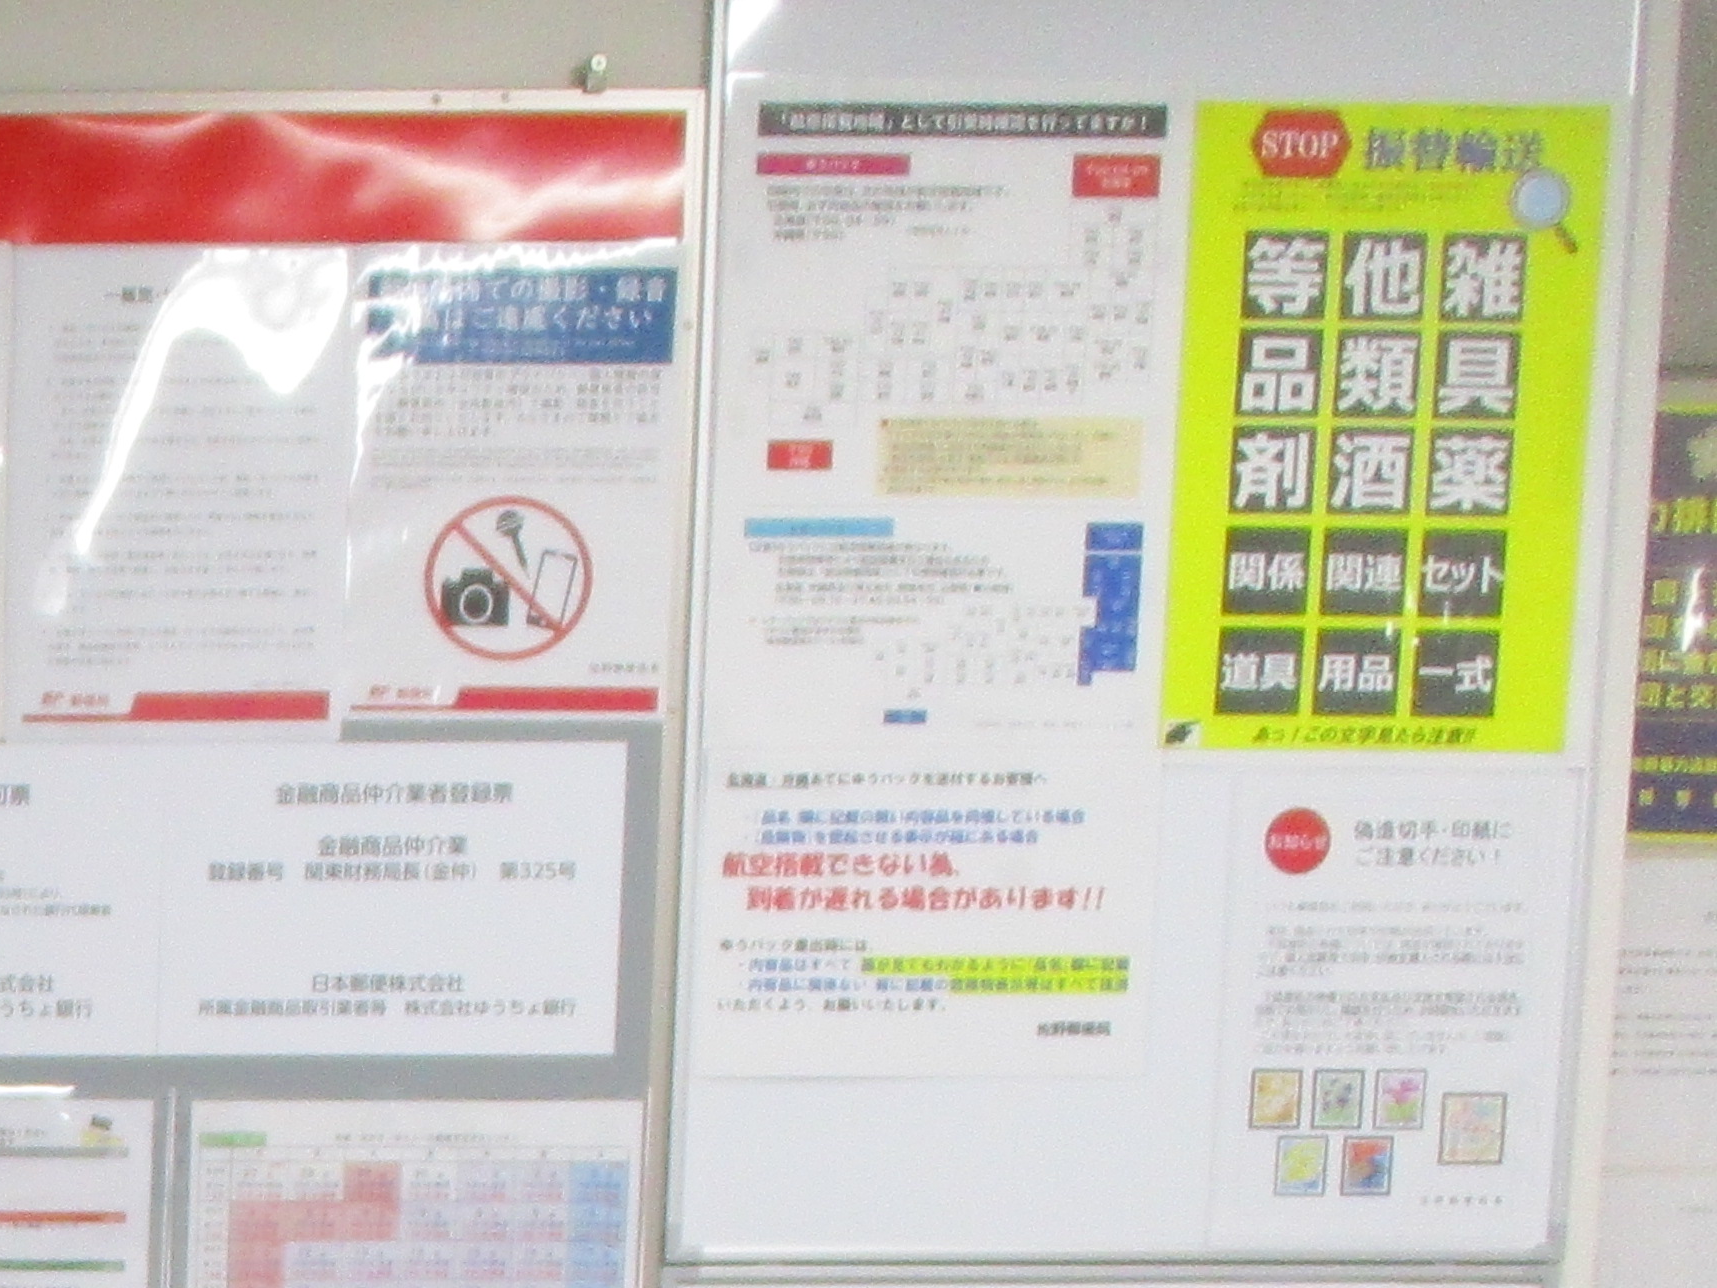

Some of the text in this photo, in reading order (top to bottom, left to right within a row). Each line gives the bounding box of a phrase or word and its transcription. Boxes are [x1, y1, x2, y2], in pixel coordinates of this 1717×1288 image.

[1260, 130, 1339, 158] STOP
[1247, 236, 1522, 317] 等 他 雑
[1239, 335, 1318, 414] 品
[1338, 335, 1417, 414] 類
[1439, 337, 1514, 414] 具
[1233, 433, 1508, 512] 剤 酒 薬
[1229, 552, 1502, 591] 関係 関連 セット
[1222, 655, 1494, 691] 道具 用品 一式
[275, 782, 514, 805] 金融商品仲介業者登録票
[317, 834, 468, 857] 金融商品仲介業
[207, 861, 285, 882] 登録番号
[499, 861, 577, 882] 第325号
[311, 973, 464, 993] 日本郵便株式会社
[403, 998, 577, 1017] 株式会社ゆうちょ銀行
